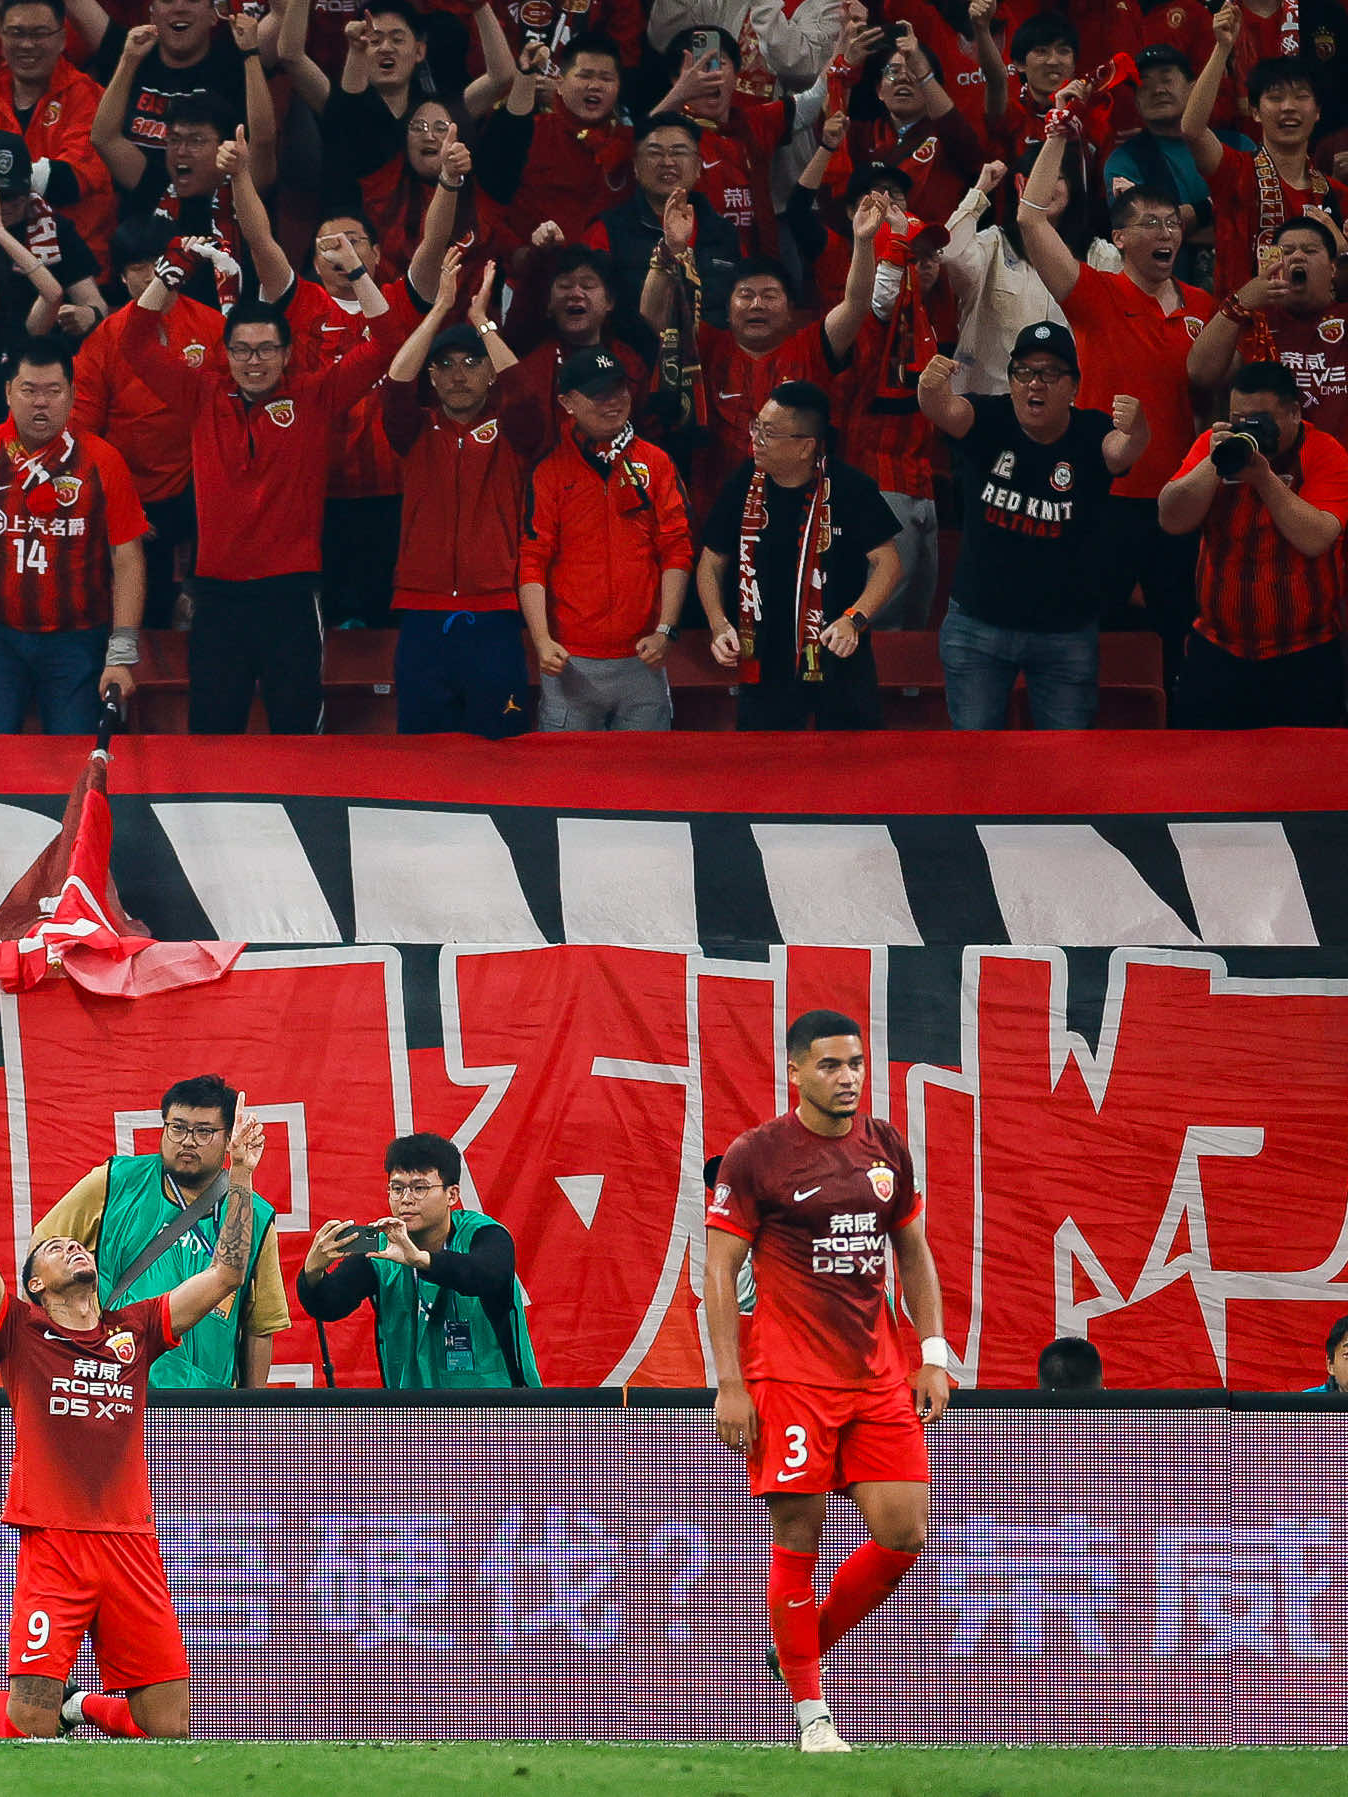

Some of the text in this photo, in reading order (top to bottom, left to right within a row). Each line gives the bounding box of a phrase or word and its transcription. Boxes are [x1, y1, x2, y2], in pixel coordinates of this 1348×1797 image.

[1280, 351, 1326, 370] 荣威
[981, 481, 1072, 521] RED KNIT
[7, 515, 86, 536] 上汽名爵
[13, 538, 47, 575] 14
[829, 1212, 877, 1234] 荣威
[812, 1235, 884, 1252] ROEW
[73, 1358, 122, 1382] 荣威
[52, 1377, 133, 1400] ROEWE
[49, 1396, 90, 1417] D5
[784, 1424, 808, 1468] 3
[939, 1512, 1333, 1660] 荣威
[27, 1610, 50, 1650] 9
